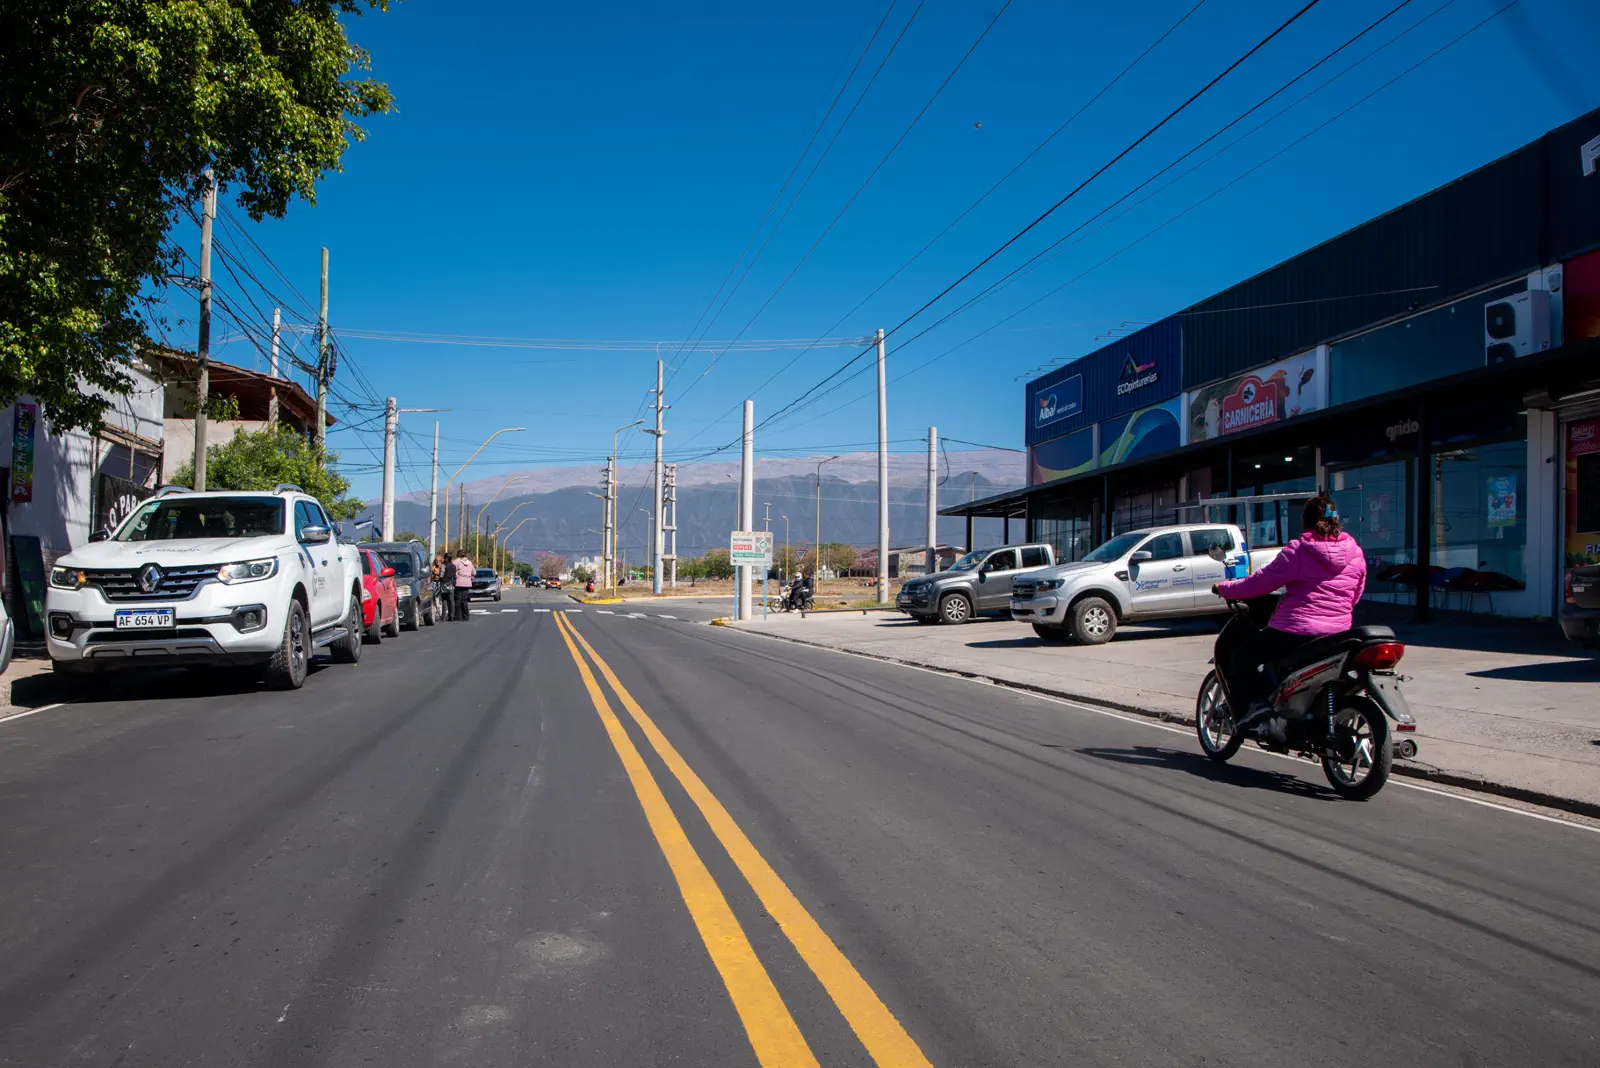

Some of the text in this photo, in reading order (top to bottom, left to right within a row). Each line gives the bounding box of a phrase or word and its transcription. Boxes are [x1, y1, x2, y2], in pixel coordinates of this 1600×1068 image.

[1225, 396, 1275, 429] CARNICERÍA
[1141, 578, 1168, 586] Catamarca
[119, 614, 170, 627] AF 654 VP
